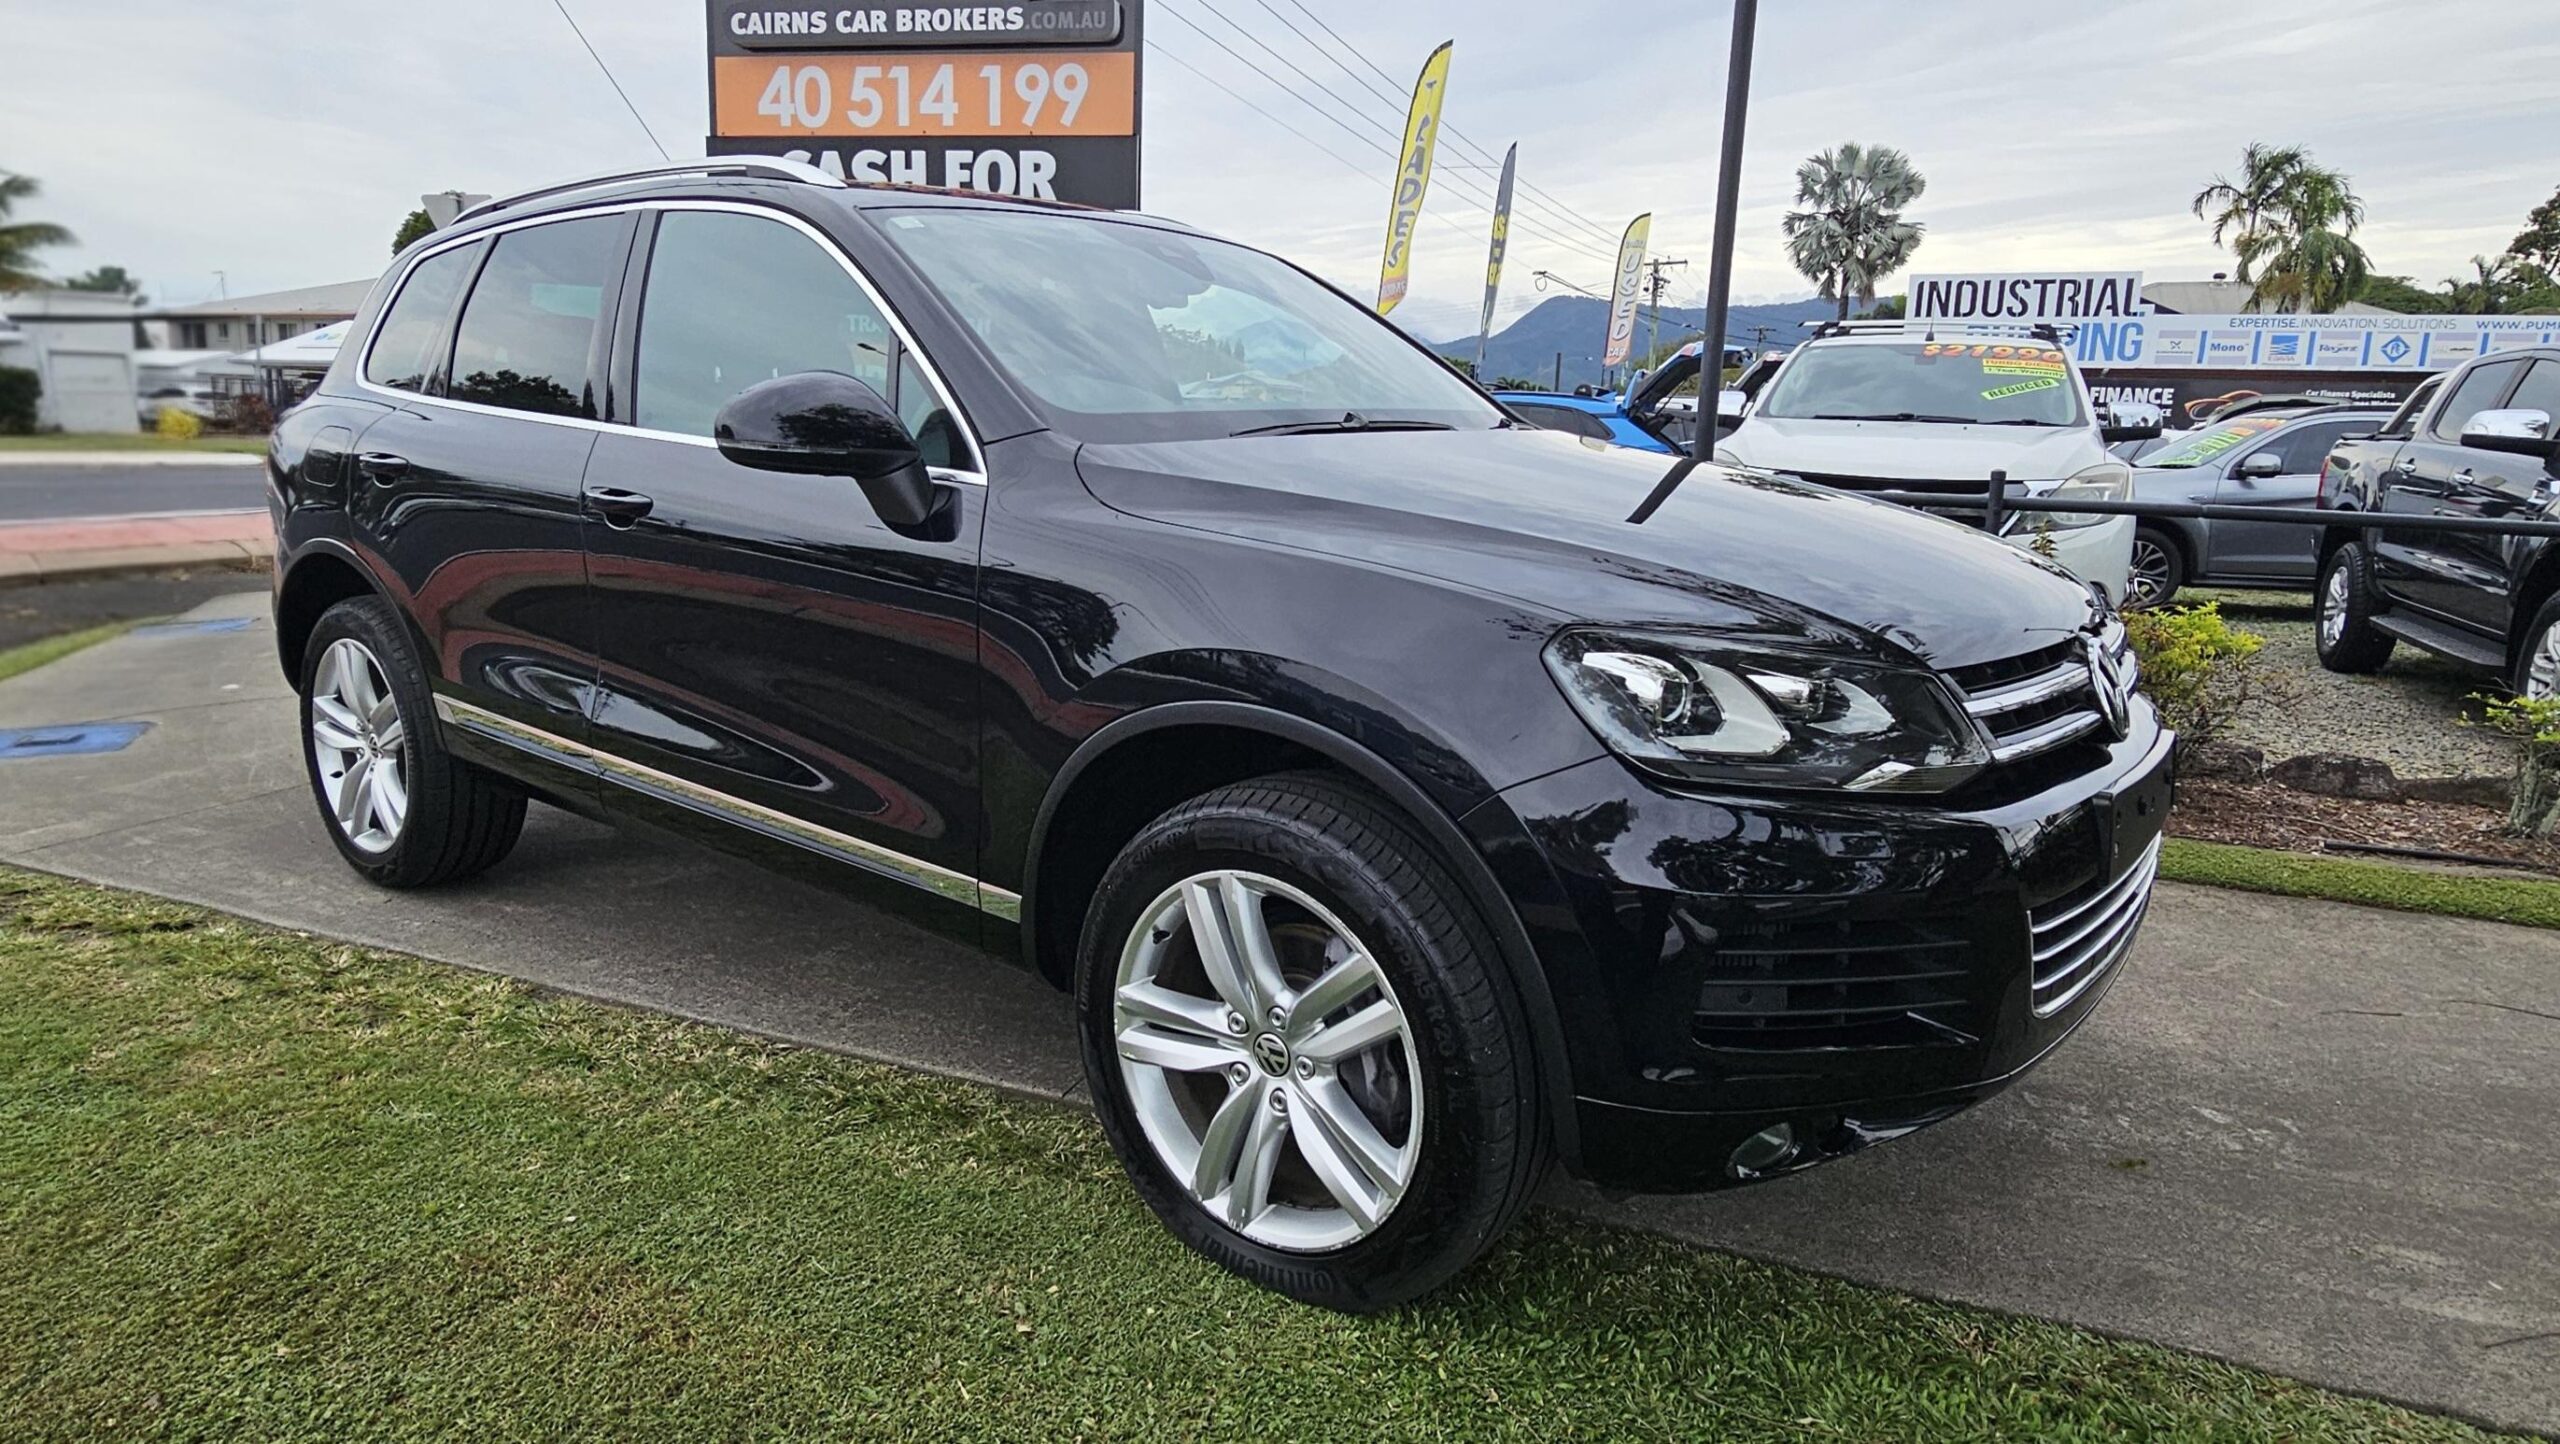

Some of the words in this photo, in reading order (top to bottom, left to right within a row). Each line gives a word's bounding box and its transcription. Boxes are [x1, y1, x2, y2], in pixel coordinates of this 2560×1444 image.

[731, 11, 827, 36] CAIRNS
[836, 10, 892, 33] CAR
[758, 65, 831, 128] 40
[846, 64, 959, 128] 514
[979, 63, 1089, 127] 199
[945, 149, 1057, 201] FOR
[1612, 252, 1643, 342] USED
[1914, 278, 2145, 318] INDUSTRIAL
[2383, 318, 2457, 330] SOLUTIONS
[1988, 379, 2051, 399] REDUCED
[2090, 386, 2175, 405] FINANCE
